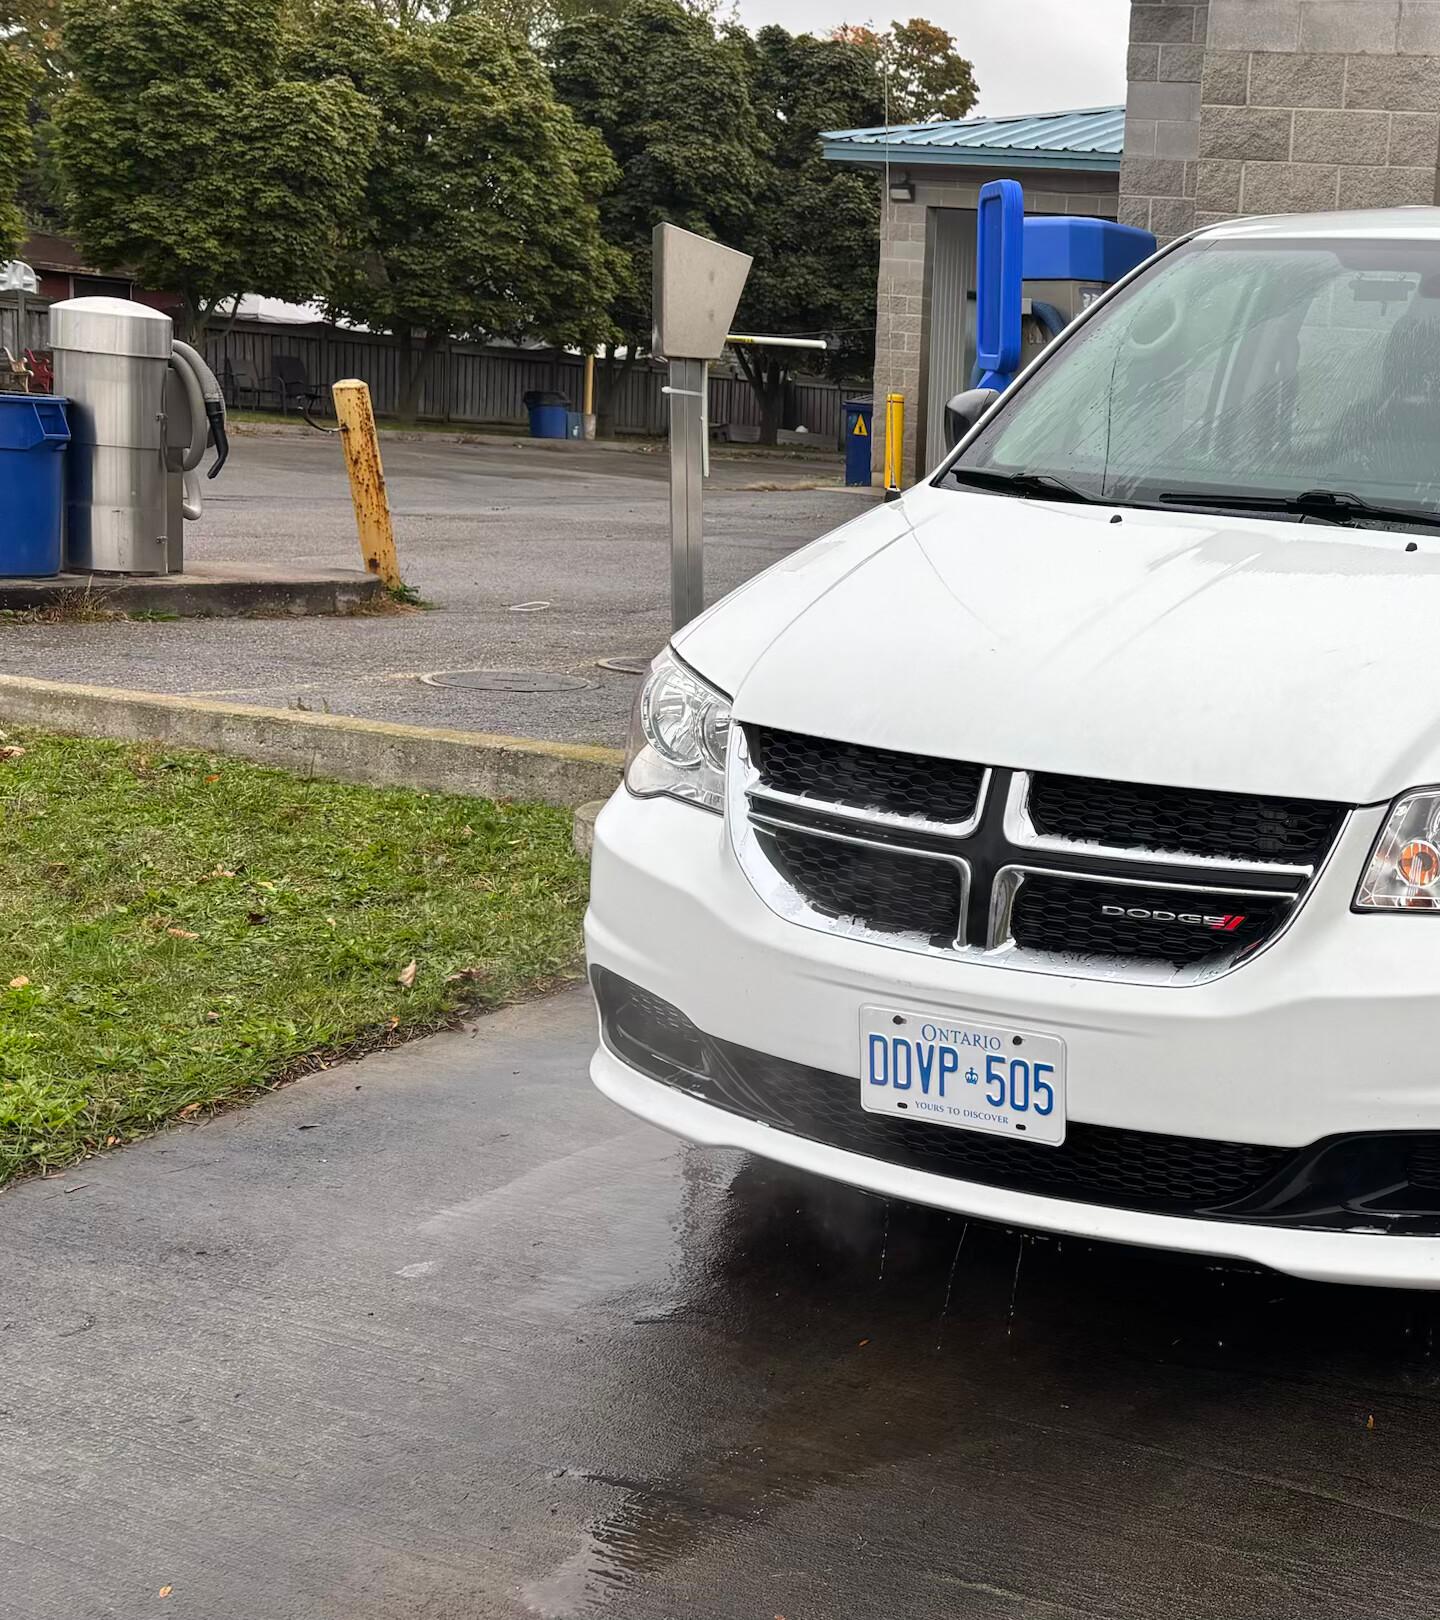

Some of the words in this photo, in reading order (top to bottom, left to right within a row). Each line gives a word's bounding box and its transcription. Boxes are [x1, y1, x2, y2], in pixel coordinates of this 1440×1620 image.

[1101, 905, 1226, 927] DODGE
[921, 1023, 1002, 1051] ONTARIO
[868, 1034, 960, 1097] DDVP
[985, 1054, 1055, 1116] 505
[914, 1100, 945, 1113] YOURS
[947, 1106, 961, 1116] TO
[963, 1109, 1009, 1125] DISCOVER
